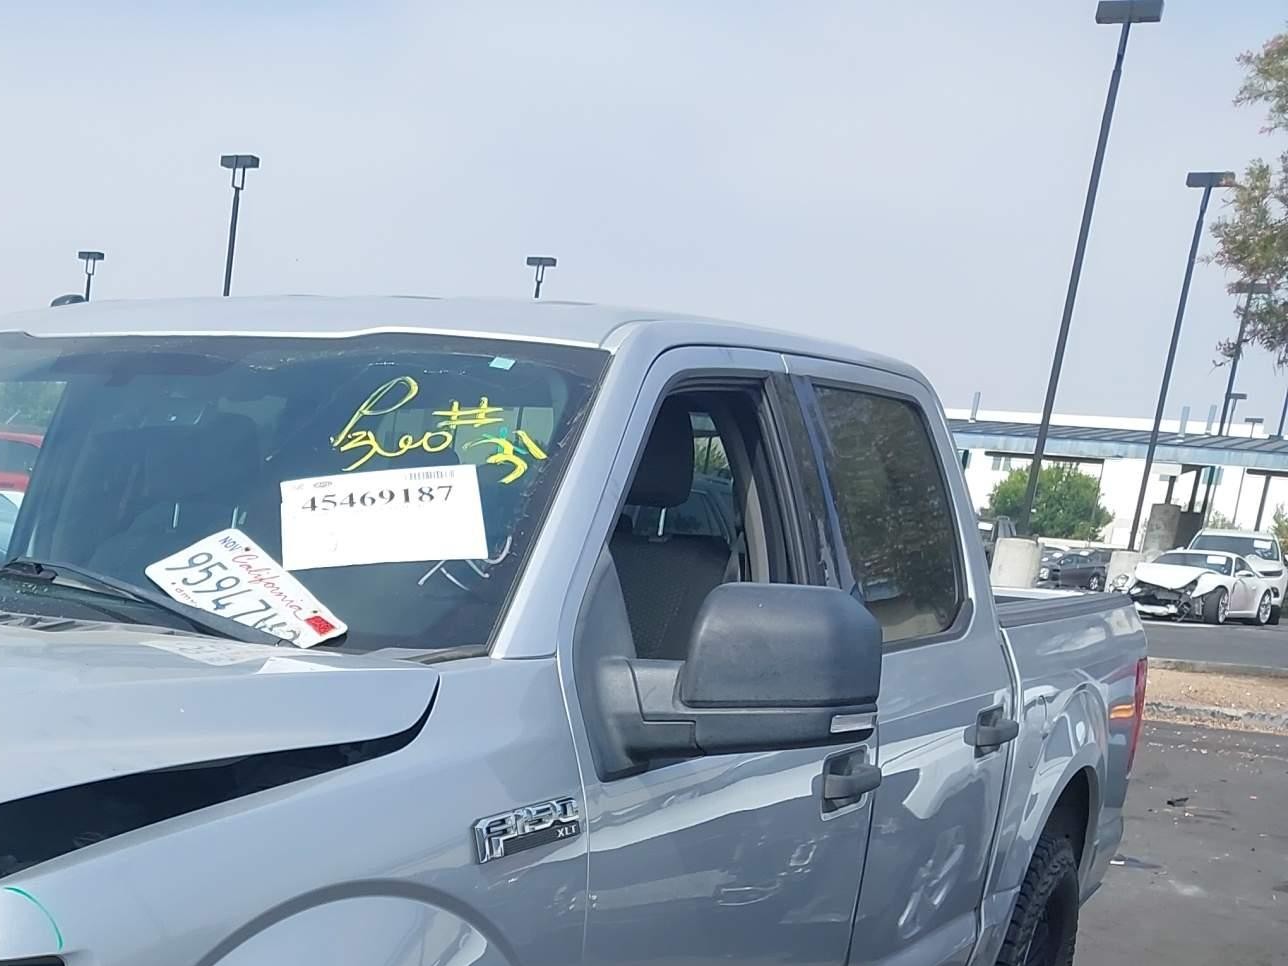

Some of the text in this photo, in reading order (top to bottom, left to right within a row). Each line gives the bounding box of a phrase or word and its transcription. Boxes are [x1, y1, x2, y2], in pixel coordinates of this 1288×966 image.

[301, 485, 453, 512] 45469187
[232, 554, 305, 621] California
[556, 824, 578, 838] XLT
